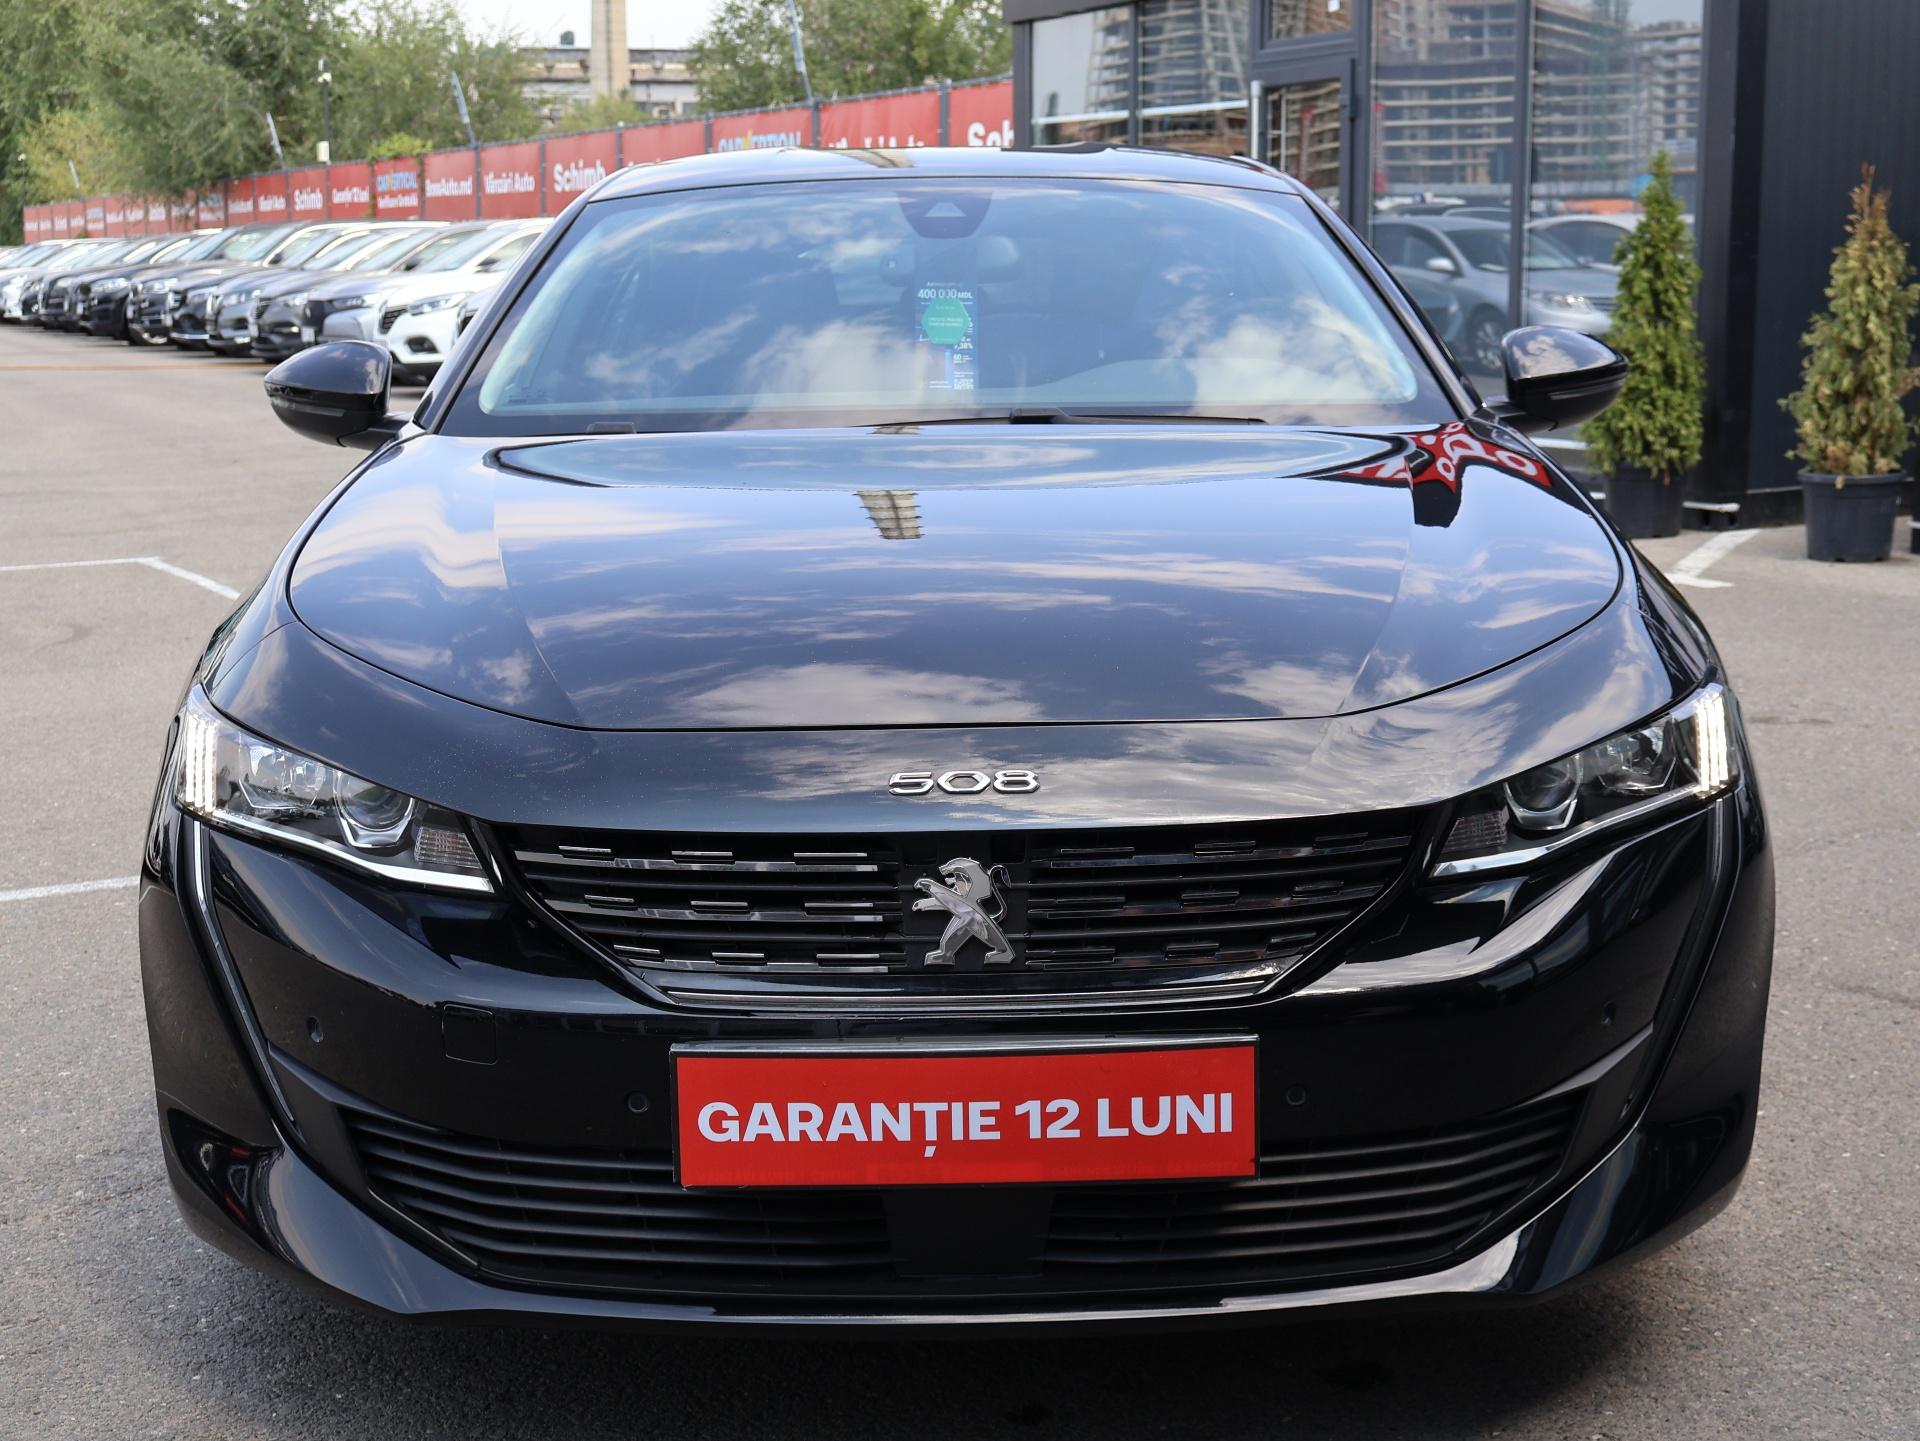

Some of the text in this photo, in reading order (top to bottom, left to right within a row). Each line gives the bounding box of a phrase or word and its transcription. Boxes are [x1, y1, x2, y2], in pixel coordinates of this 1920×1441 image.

[918, 289, 937, 299] 400
[889, 770, 1040, 796] 508
[698, 1092, 1233, 1158] GARANȚIE 12 LUNI
